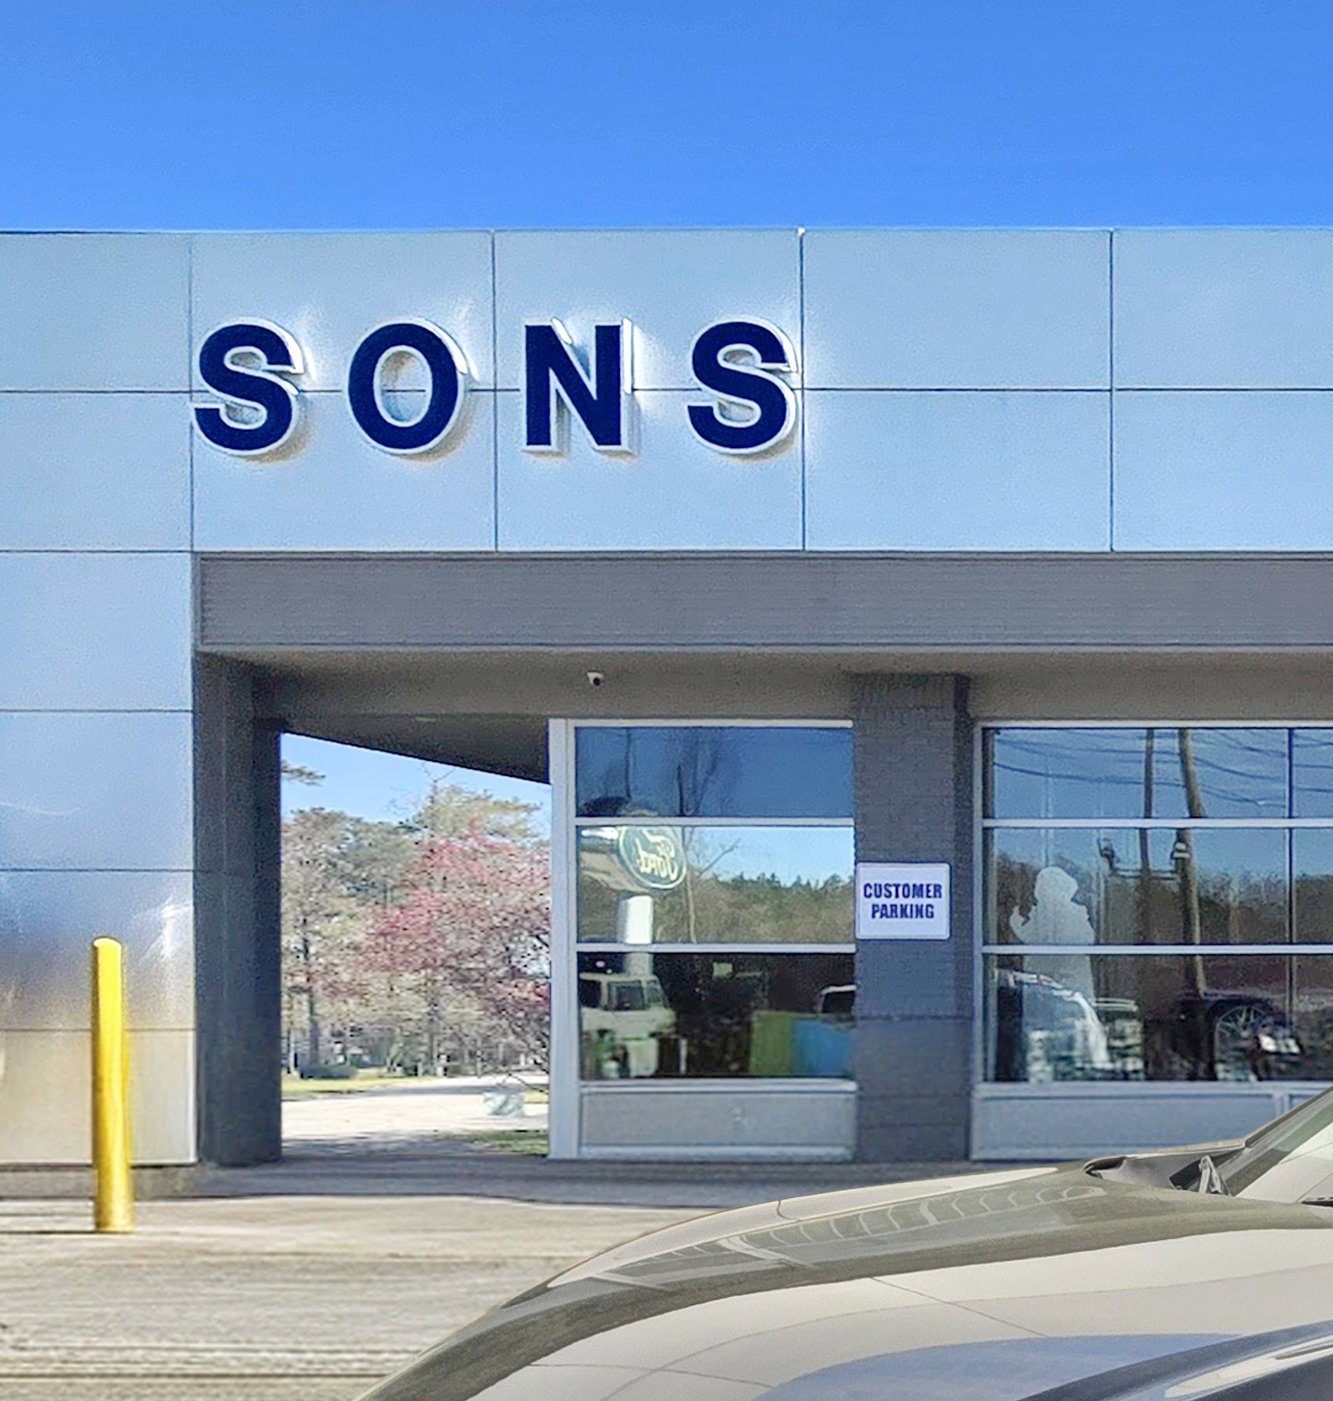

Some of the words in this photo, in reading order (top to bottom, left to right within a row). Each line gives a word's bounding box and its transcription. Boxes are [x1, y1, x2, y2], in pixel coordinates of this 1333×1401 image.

[192, 318, 795, 452] SONS
[863, 882, 943, 899] CUSTOMER
[871, 903, 935, 919] PARKING
